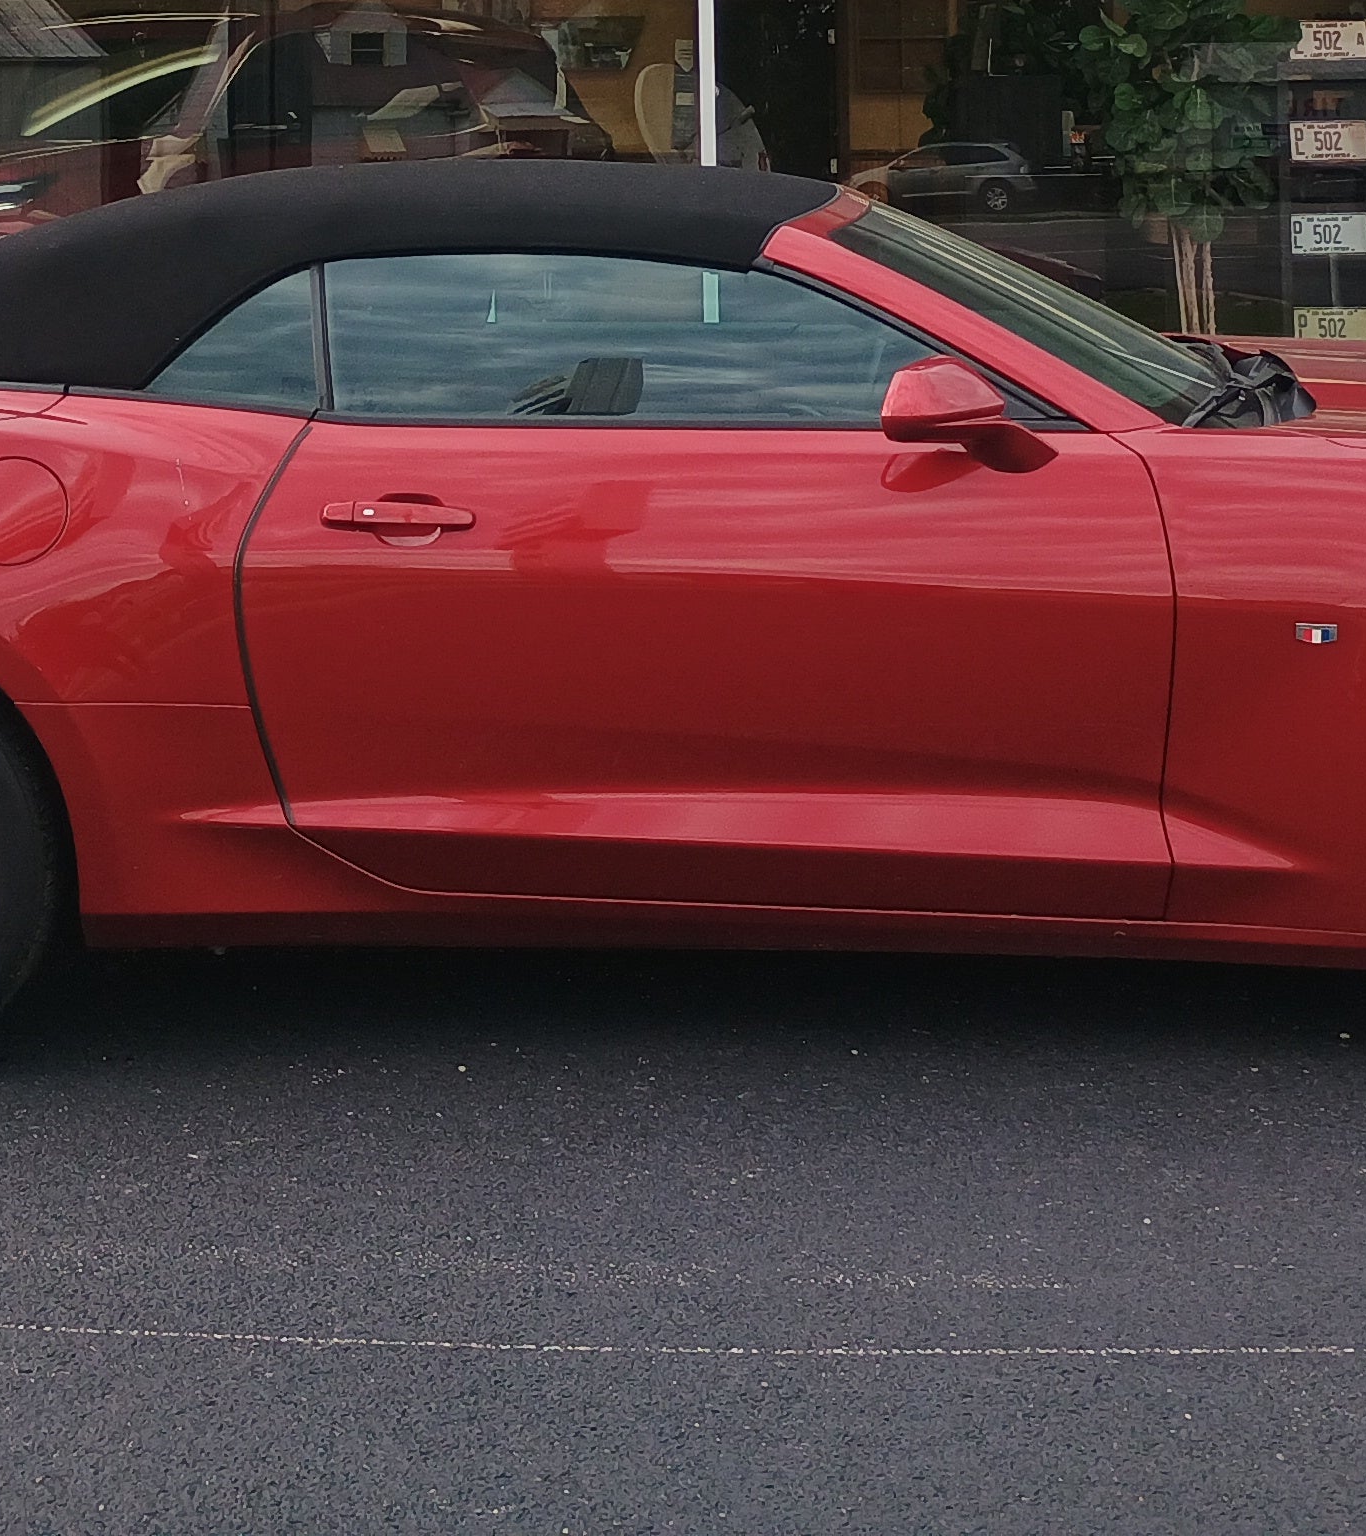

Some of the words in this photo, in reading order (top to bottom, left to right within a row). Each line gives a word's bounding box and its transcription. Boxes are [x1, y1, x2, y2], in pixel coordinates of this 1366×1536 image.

[1313, 31, 1342, 50] 502
[1356, 33, 1364, 46] A
[1314, 132, 1342, 151] 502
[1313, 224, 1342, 244] 502
[1318, 318, 1346, 338] 502
